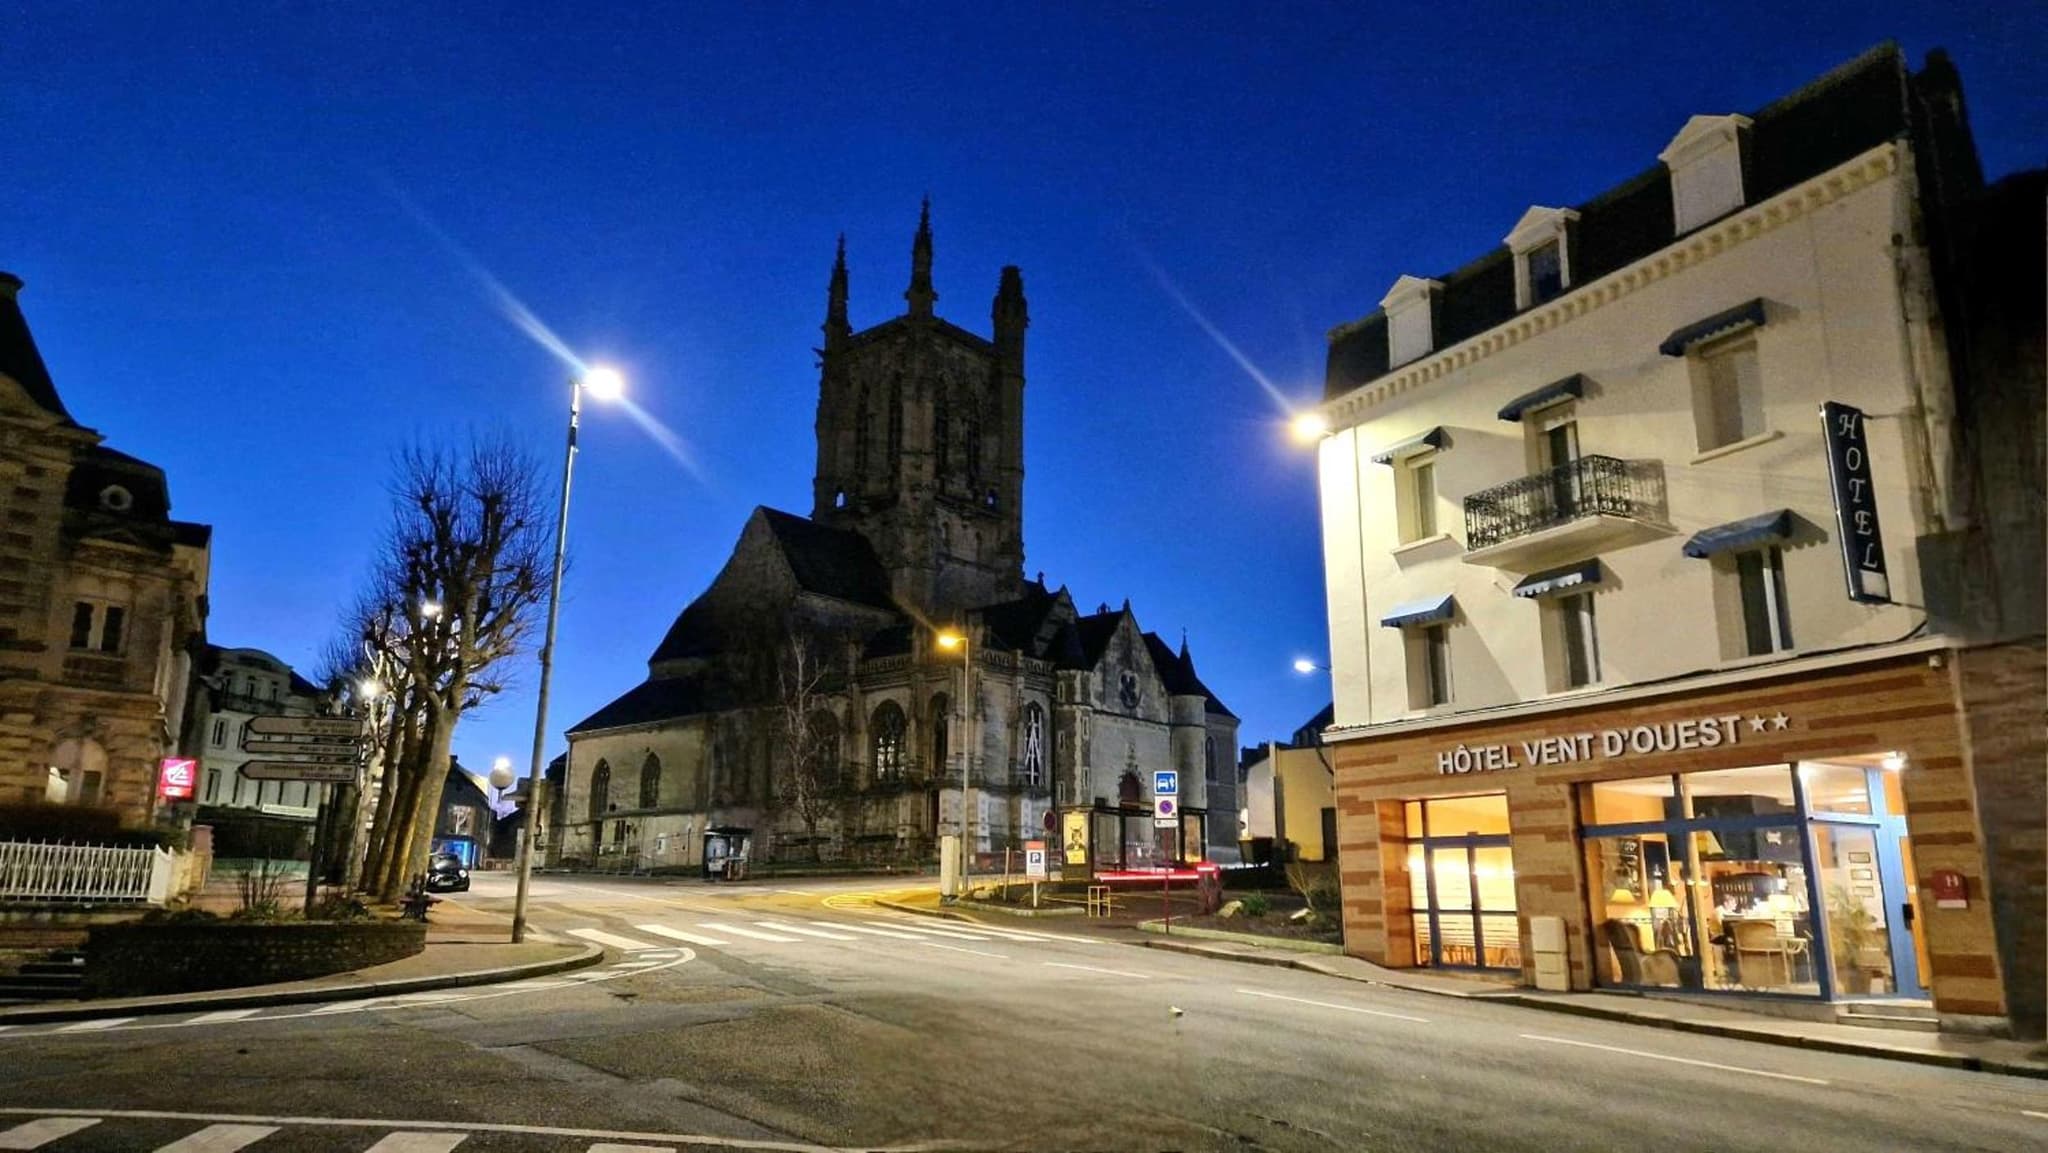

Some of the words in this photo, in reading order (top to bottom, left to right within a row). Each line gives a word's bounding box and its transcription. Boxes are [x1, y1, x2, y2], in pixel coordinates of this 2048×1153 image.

[1838, 413, 1878, 568] HOTEL
[1438, 744, 1519, 775] HÔTEL
[1522, 733, 1594, 767] VENT
[1603, 715, 1742, 758] D'OUEST
